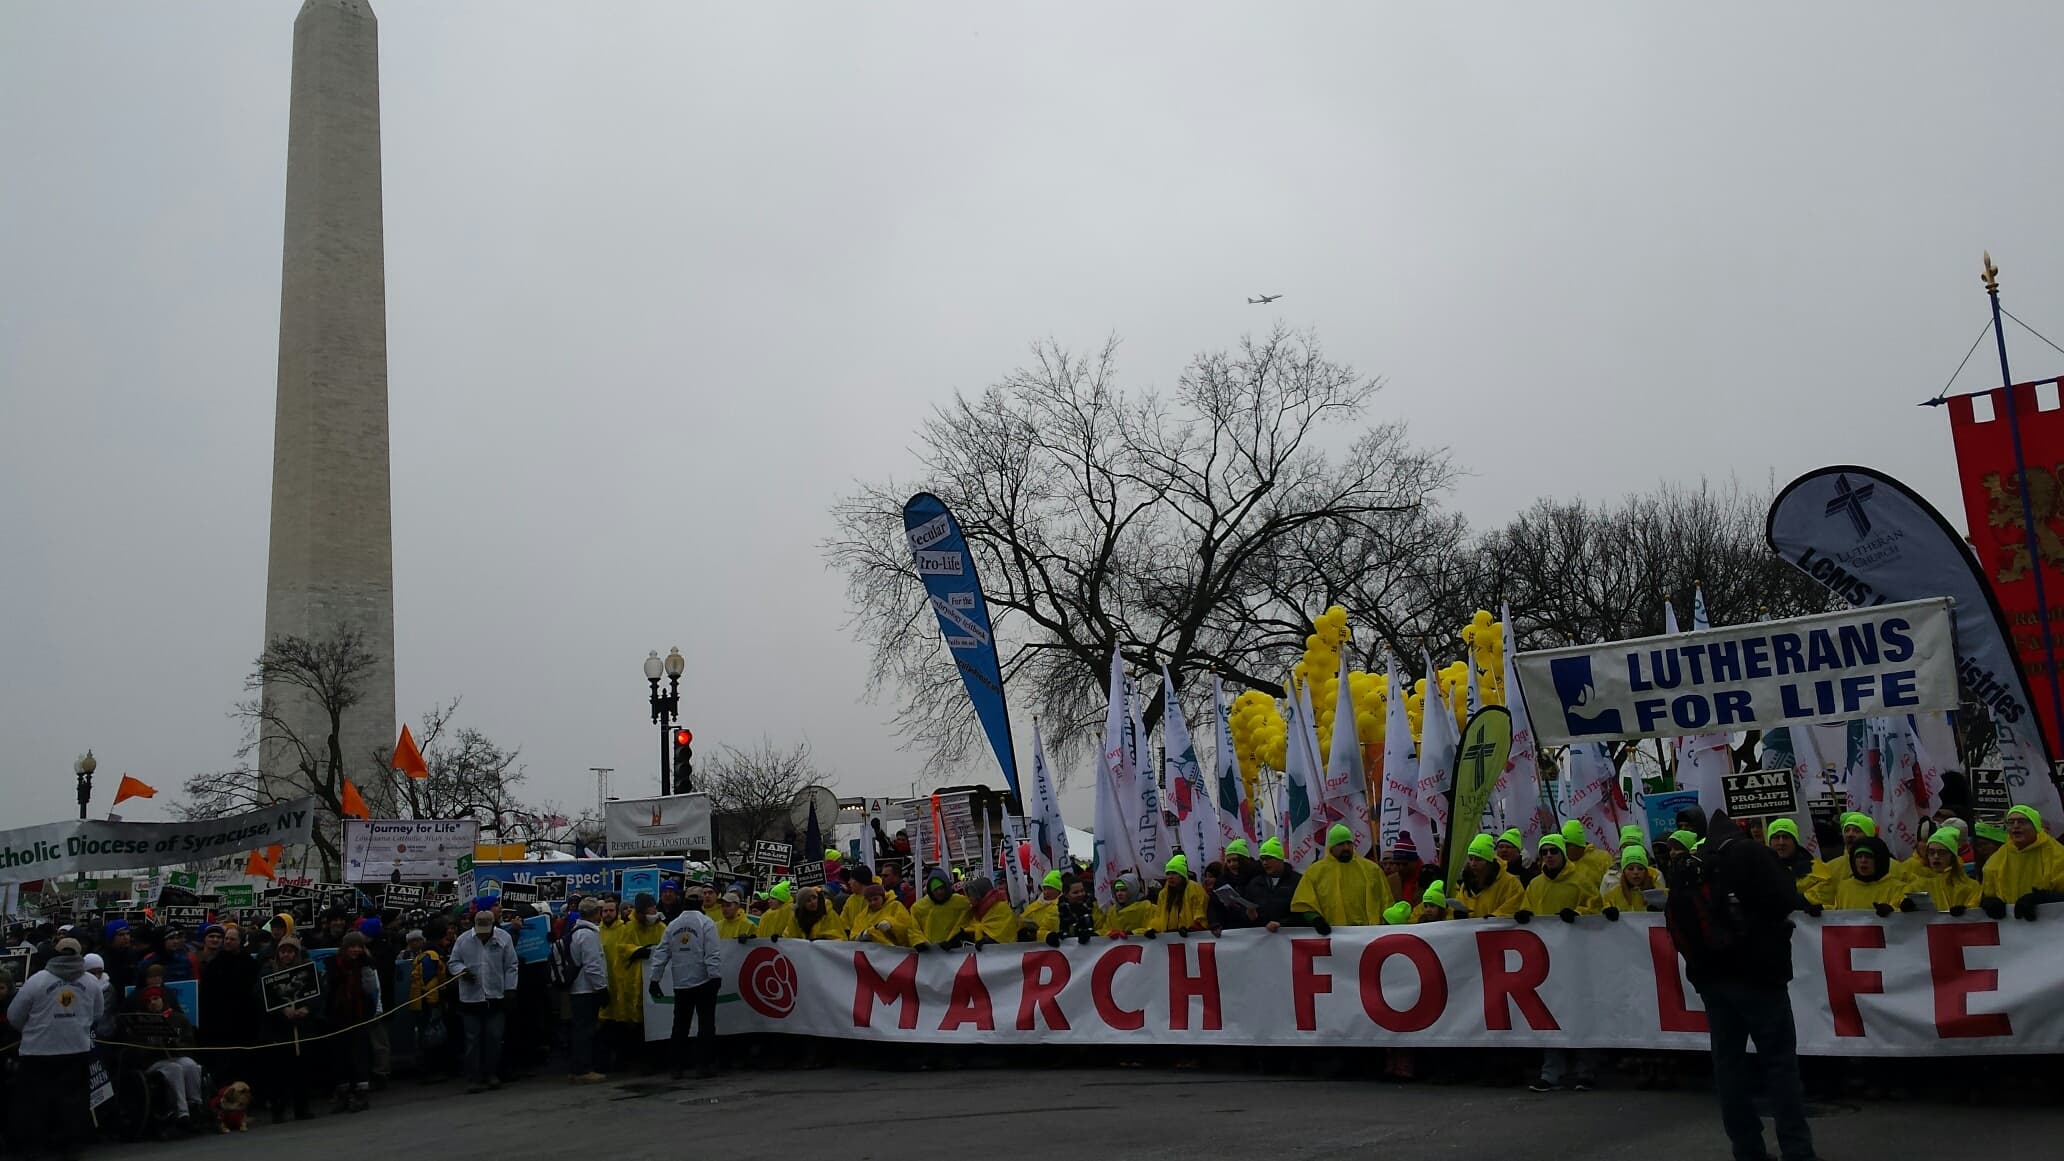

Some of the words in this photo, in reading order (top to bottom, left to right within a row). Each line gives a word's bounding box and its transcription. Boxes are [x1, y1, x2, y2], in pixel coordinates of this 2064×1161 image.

[1797, 546, 1873, 606] LCMS
[1626, 617, 1915, 693] LUTHERANS
[1960, 656, 2026, 723] istries
[1634, 690, 1757, 733] FOR
[1780, 670, 1920, 719] LIFE
[1728, 778, 1738, 791] I
[1744, 773, 1787, 788] AM
[1730, 790, 1790, 803] PRO-LIFE
[1732, 800, 1790, 811] GENERATION
[67, 835, 148, 857] Diocese
[156, 834, 178, 853] of
[182, 821, 272, 851] Syracuse,
[277, 810, 307, 829] NY
[416, 823, 432, 832] for
[611, 840, 640, 852] RESPECT
[642, 838, 660, 849] LIFE
[661, 835, 707, 847] APOSTOLATE
[767, 844, 789, 852] AM
[805, 863, 823, 873] AM
[398, 887, 421, 895] AM
[180, 908, 205, 916] AM
[852, 941, 1222, 1031] MARCH
[1291, 929, 1561, 1033] FOR
[1648, 921, 2013, 1039] LFE
